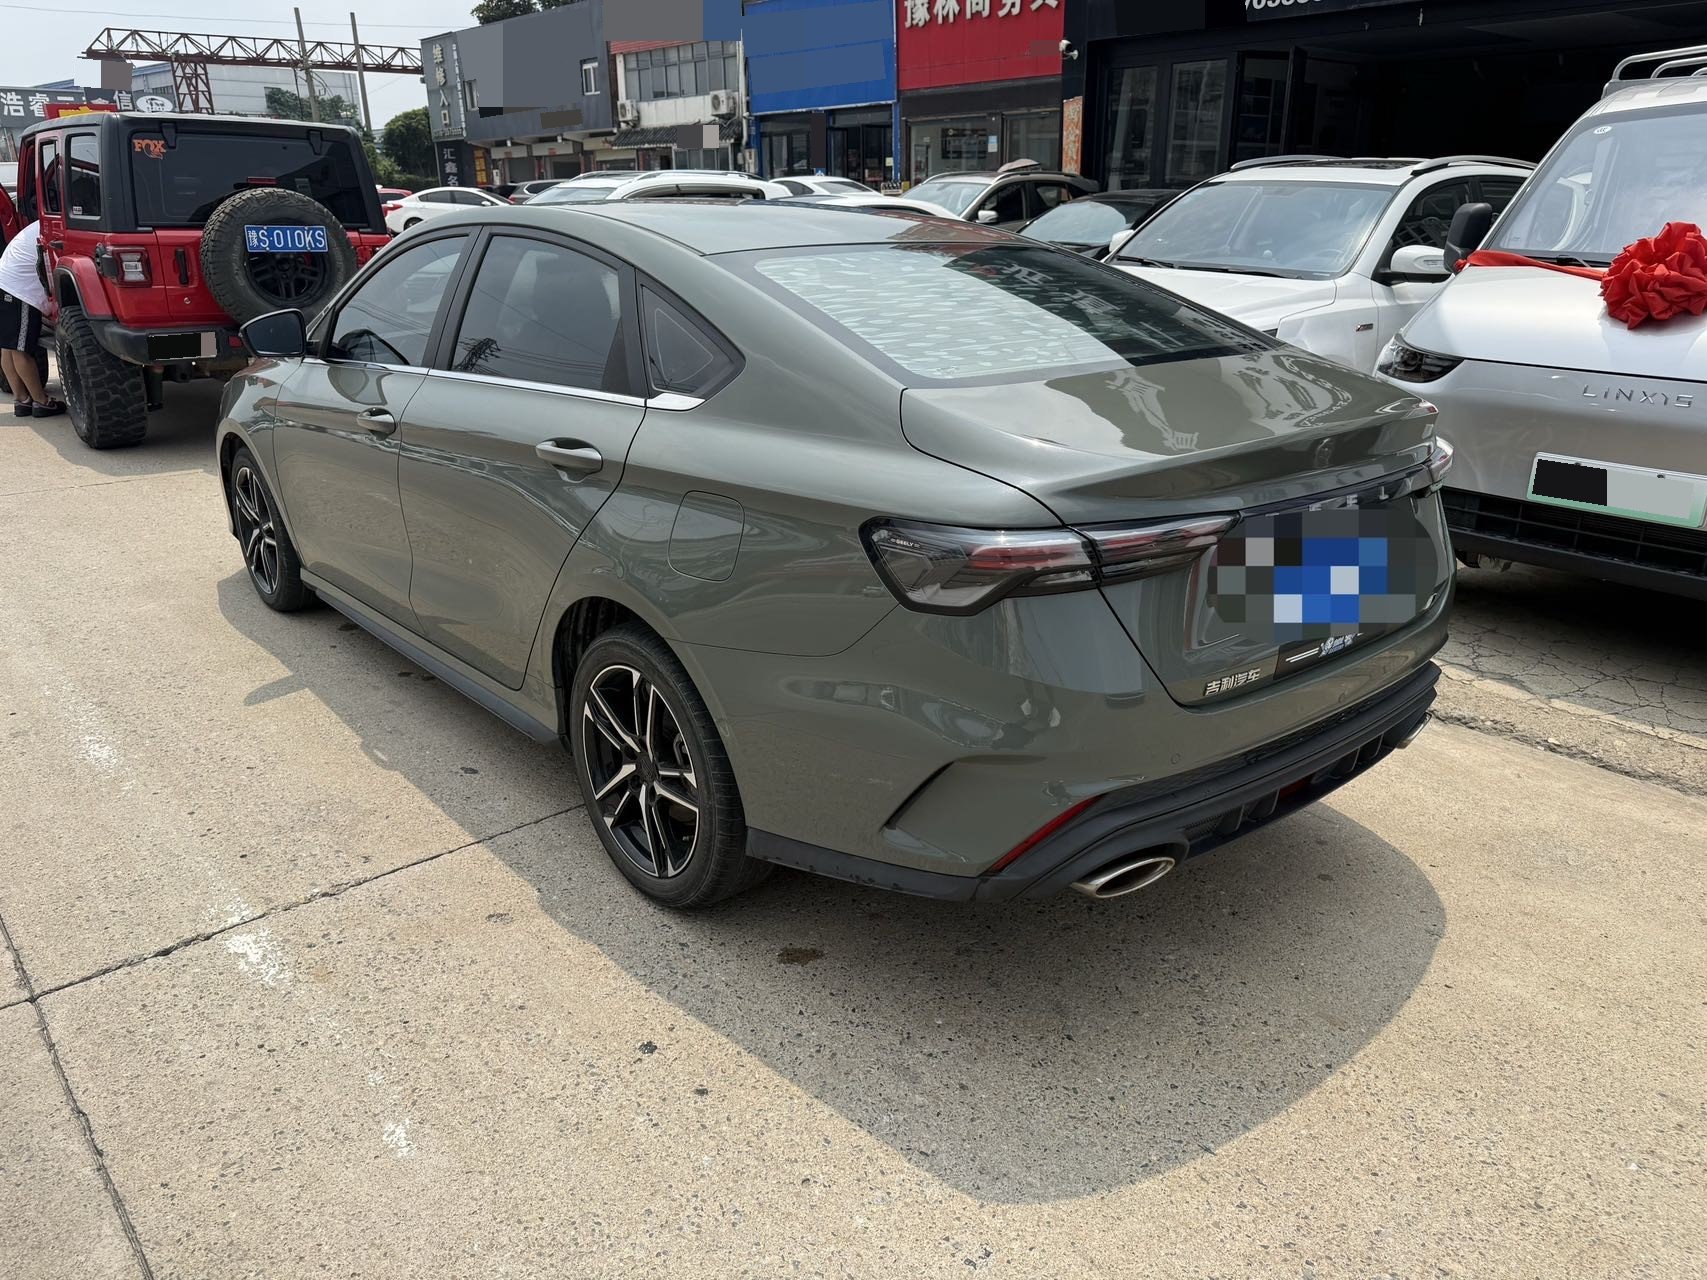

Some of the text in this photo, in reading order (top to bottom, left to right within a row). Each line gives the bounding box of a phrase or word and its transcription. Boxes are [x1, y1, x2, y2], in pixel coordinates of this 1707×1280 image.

[432, 43, 450, 127] 维修入口
[132, 139, 167, 156] FOX
[1205, 668, 1261, 696] 吉利汽车
